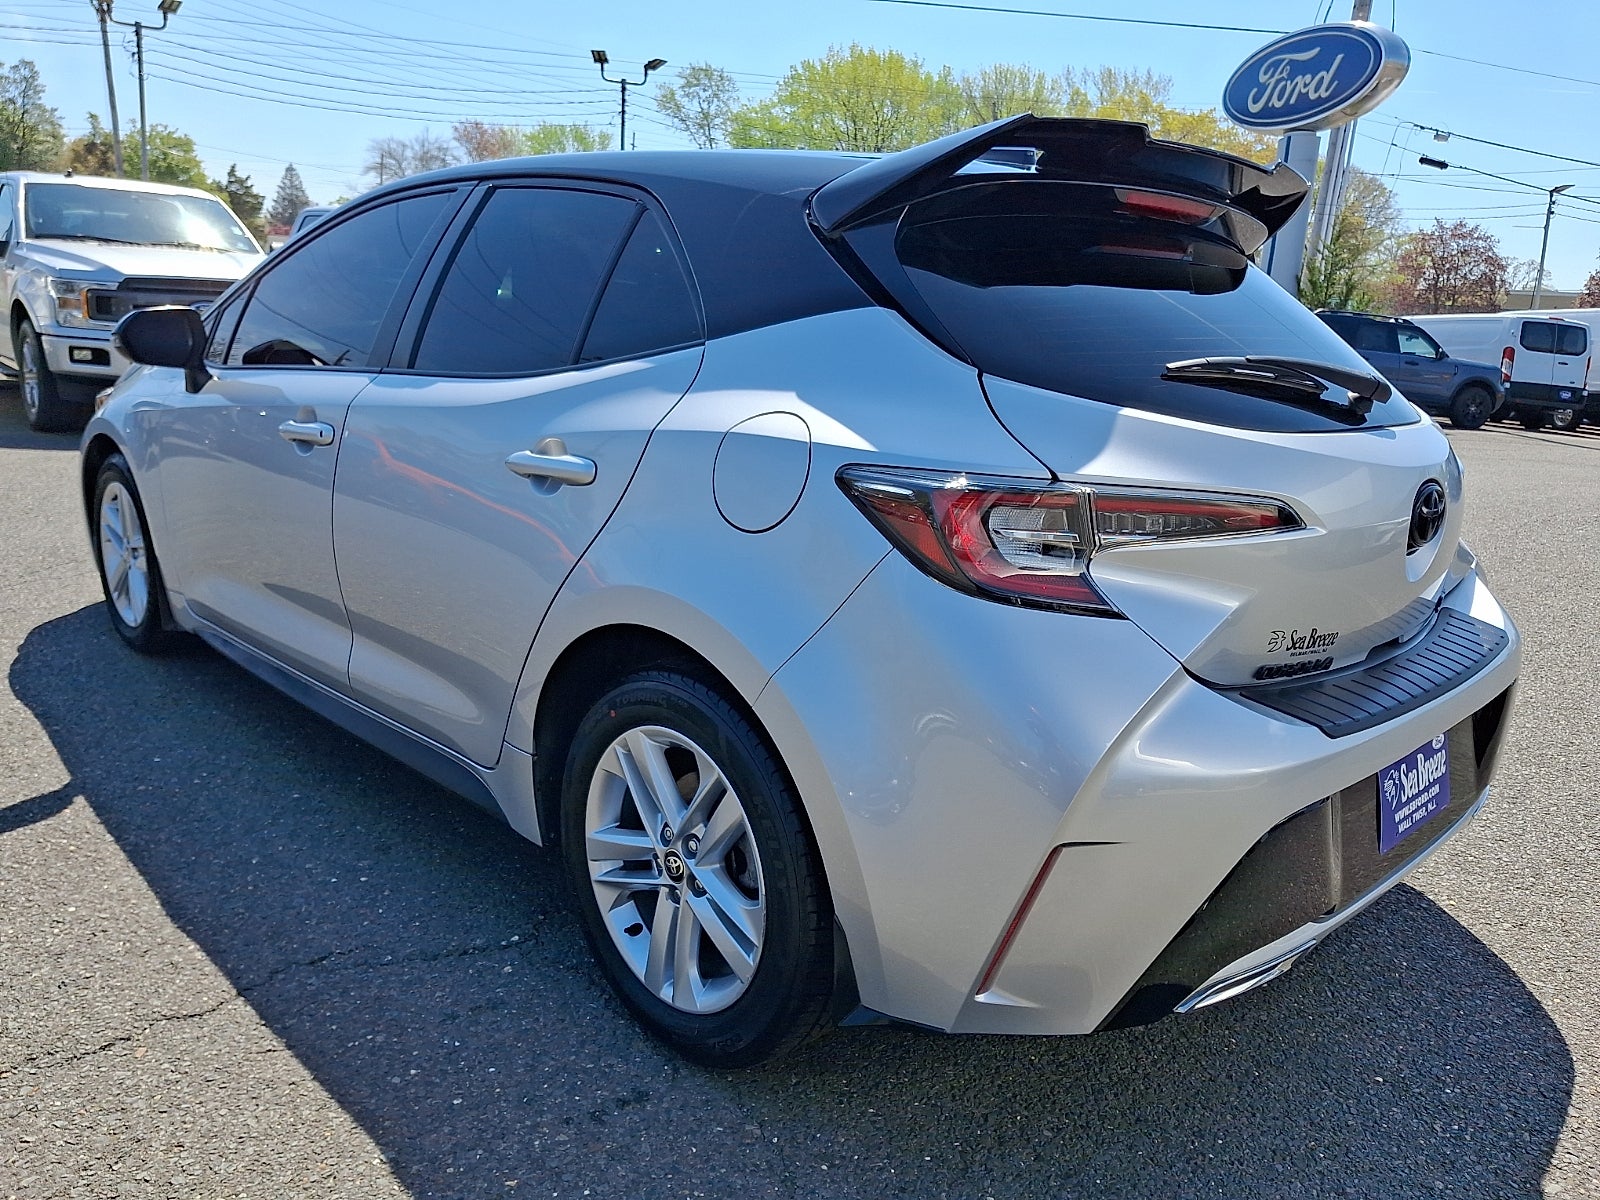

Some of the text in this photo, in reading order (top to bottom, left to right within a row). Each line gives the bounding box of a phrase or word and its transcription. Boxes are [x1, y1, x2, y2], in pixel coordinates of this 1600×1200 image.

[1247, 46, 1345, 114] Ford
[1286, 627, 1339, 652] Sea Breeze
[1400, 749, 1447, 803] Sea Breeze
[1398, 818, 1412, 833] WALL
